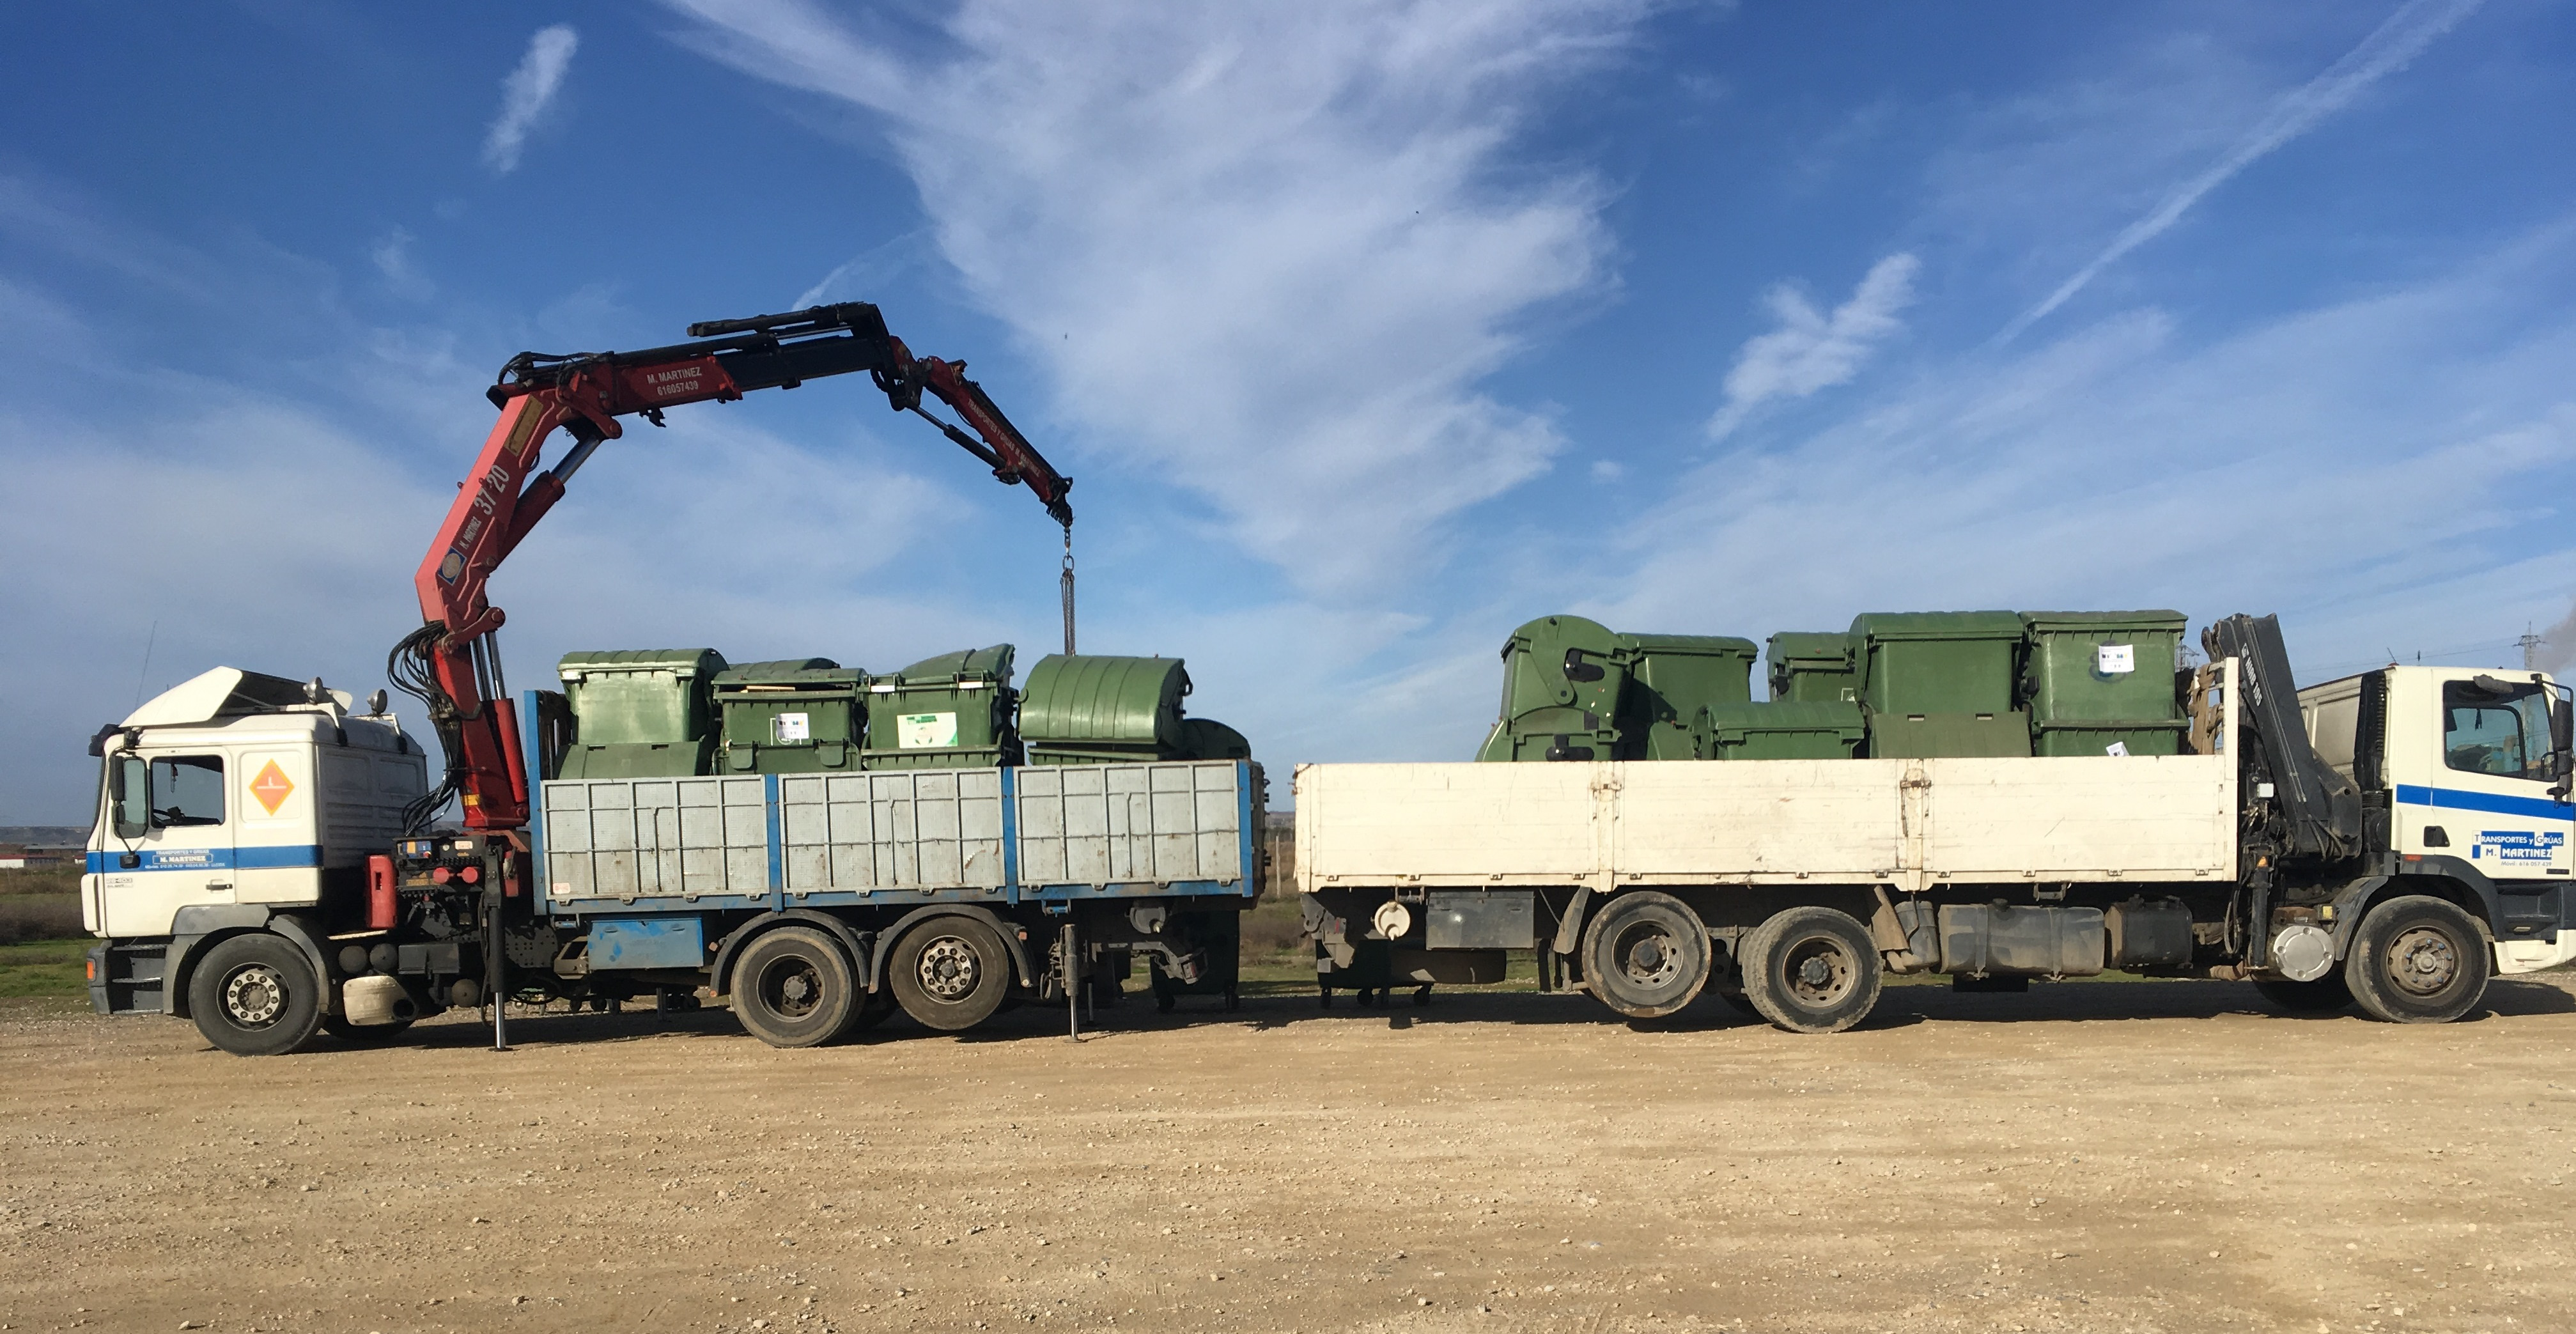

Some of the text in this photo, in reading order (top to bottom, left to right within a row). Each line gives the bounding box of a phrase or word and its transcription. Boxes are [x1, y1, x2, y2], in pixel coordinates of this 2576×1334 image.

[647, 367, 702, 384] M. MARTINEZ
[657, 380, 699, 396] 616057439
[968, 398, 997, 433] TRANSPORTES
[2246, 656, 2256, 686] HIAB
[2474, 834, 2527, 844] TRANSPORTES
[2536, 835, 2563, 844] GRÚAS
[2502, 848, 2552, 858] MARTINEZ
